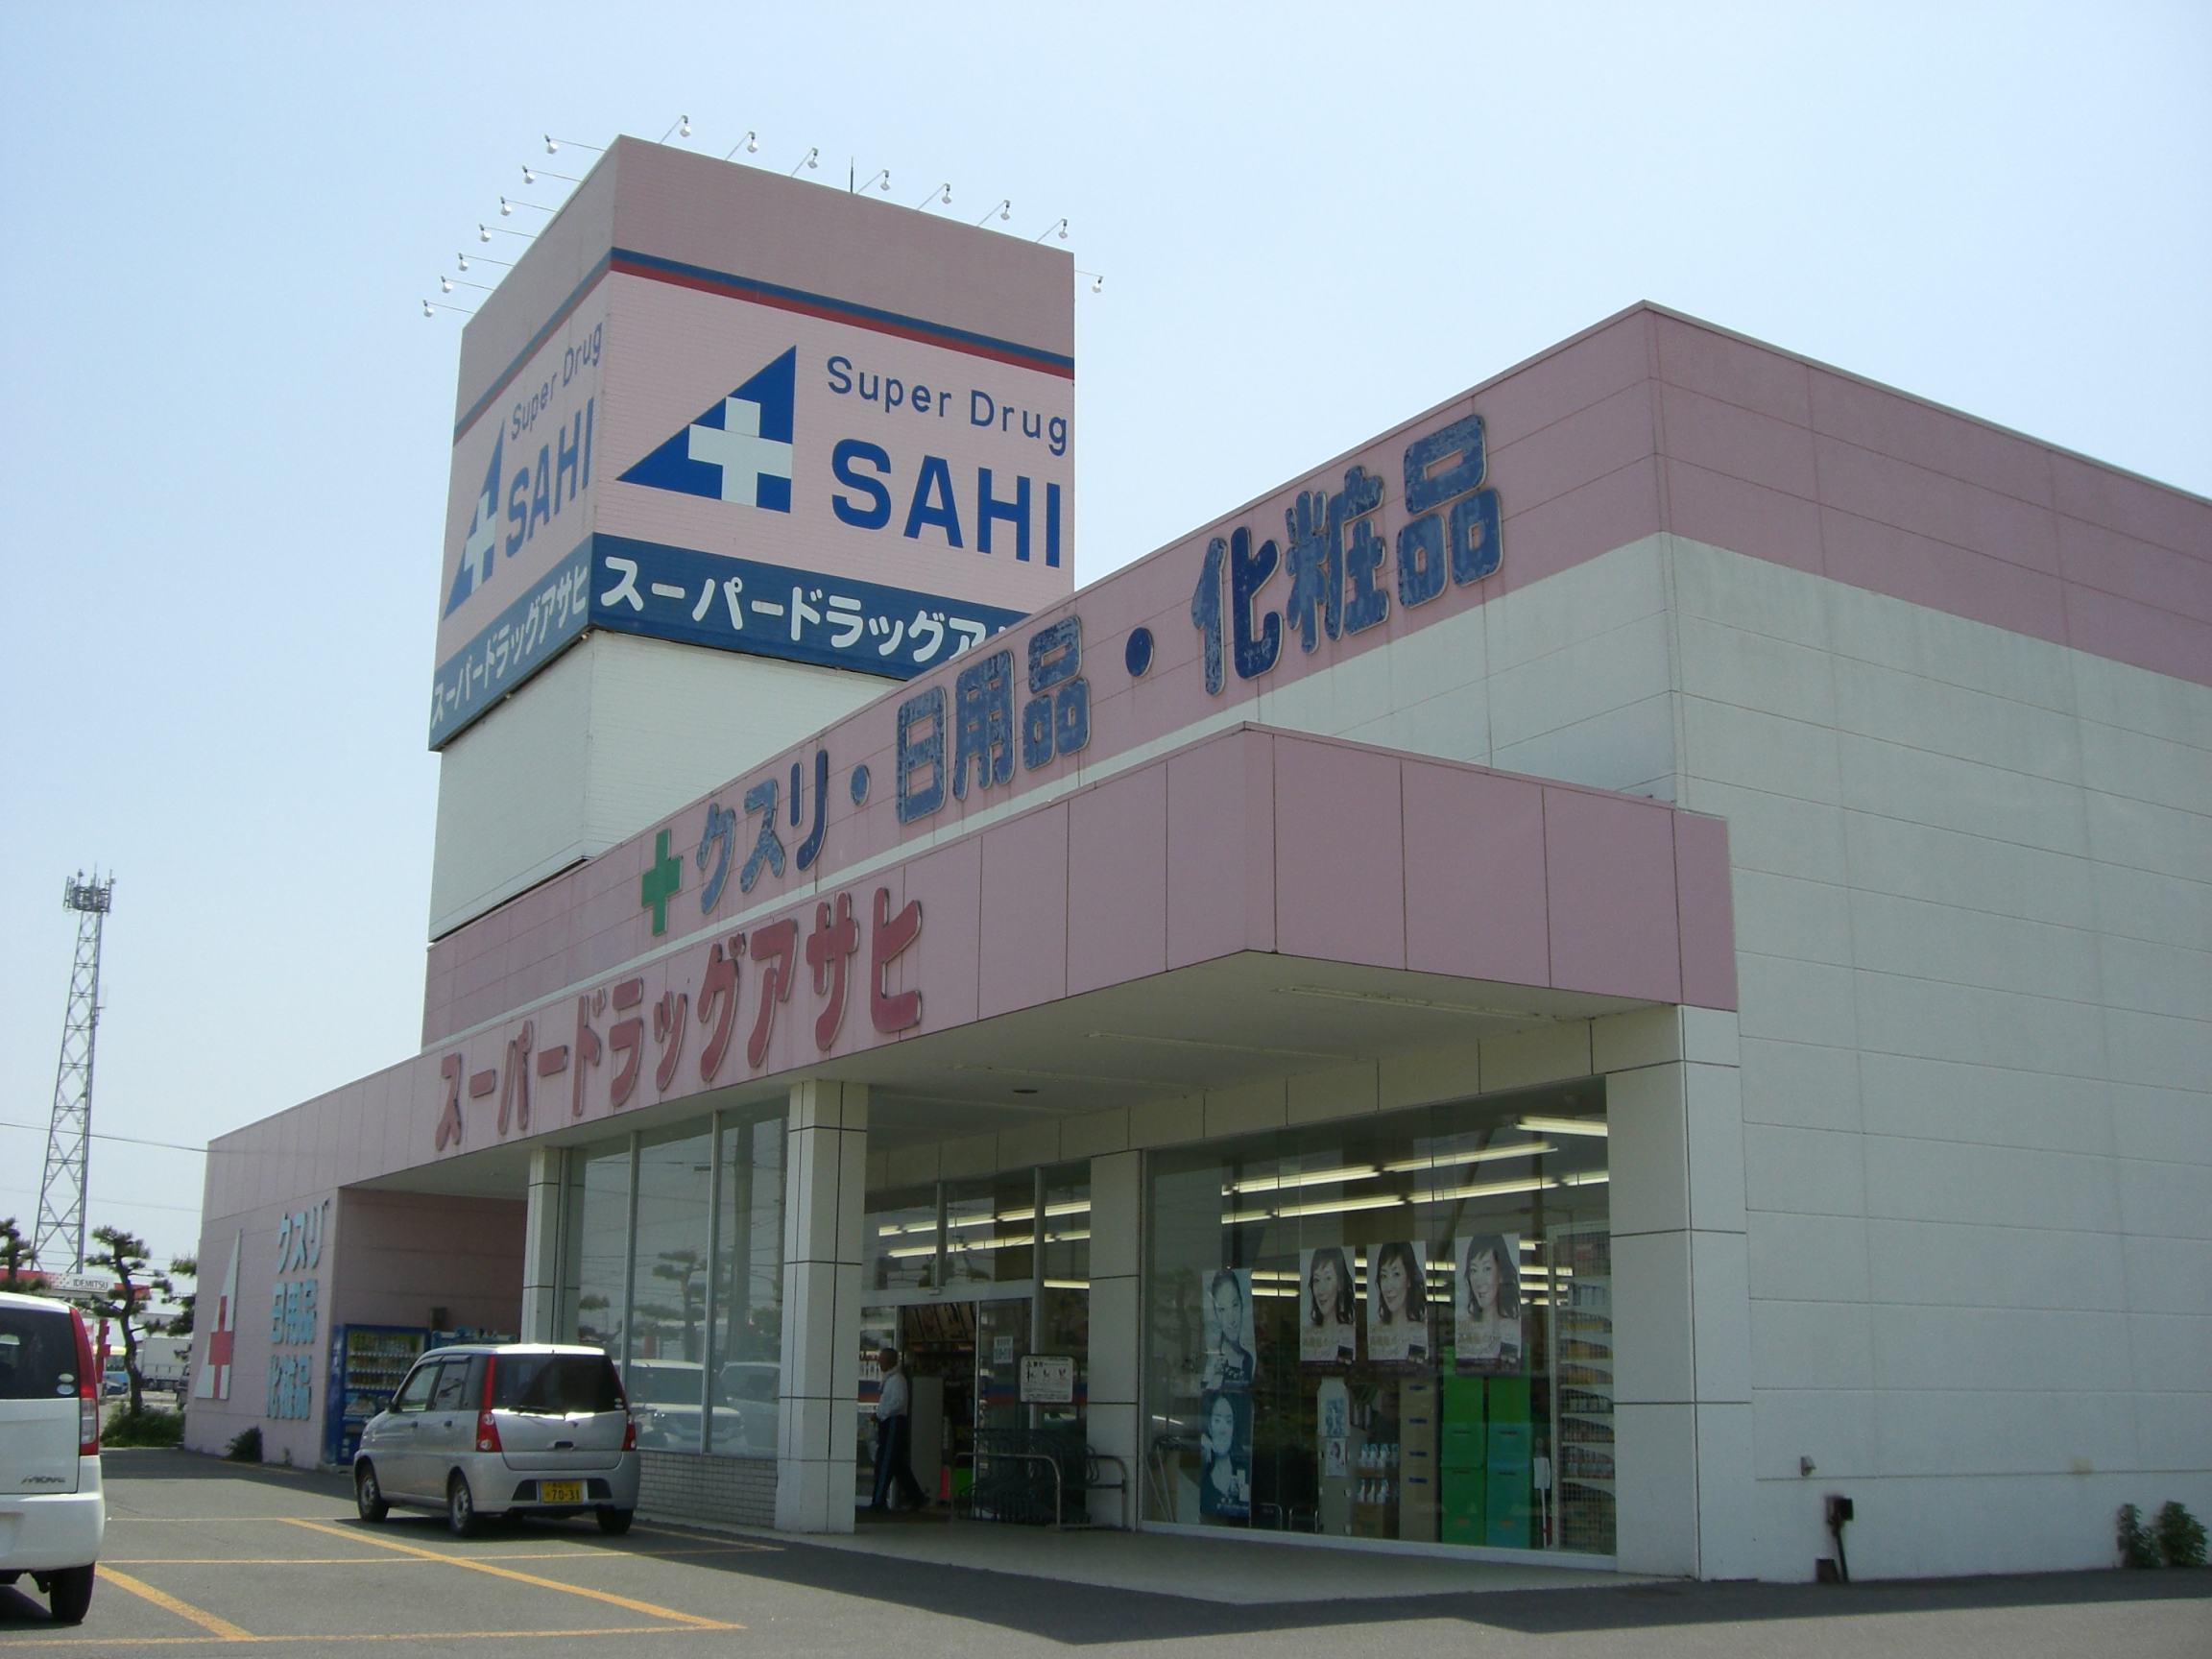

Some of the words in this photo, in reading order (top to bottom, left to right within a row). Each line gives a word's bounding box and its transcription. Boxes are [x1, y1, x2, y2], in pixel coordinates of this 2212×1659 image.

[511, 371, 558, 442] Super
[563, 322, 603, 387] Drug
[827, 355, 952, 417] Super
[970, 390, 1068, 456] Drug
[431, 565, 589, 730] スーパードラッグアサヒ
[600, 556, 1006, 664] スーパードラッグア
[435, 886, 923, 1152] スーパードラッグアサヒ
[73, 1278, 108, 1289] IDEMITSU
[277, 1206, 325, 1274] クスリ
[270, 1278, 317, 1345] 日用品
[266, 1354, 312, 1420] 化粧品
